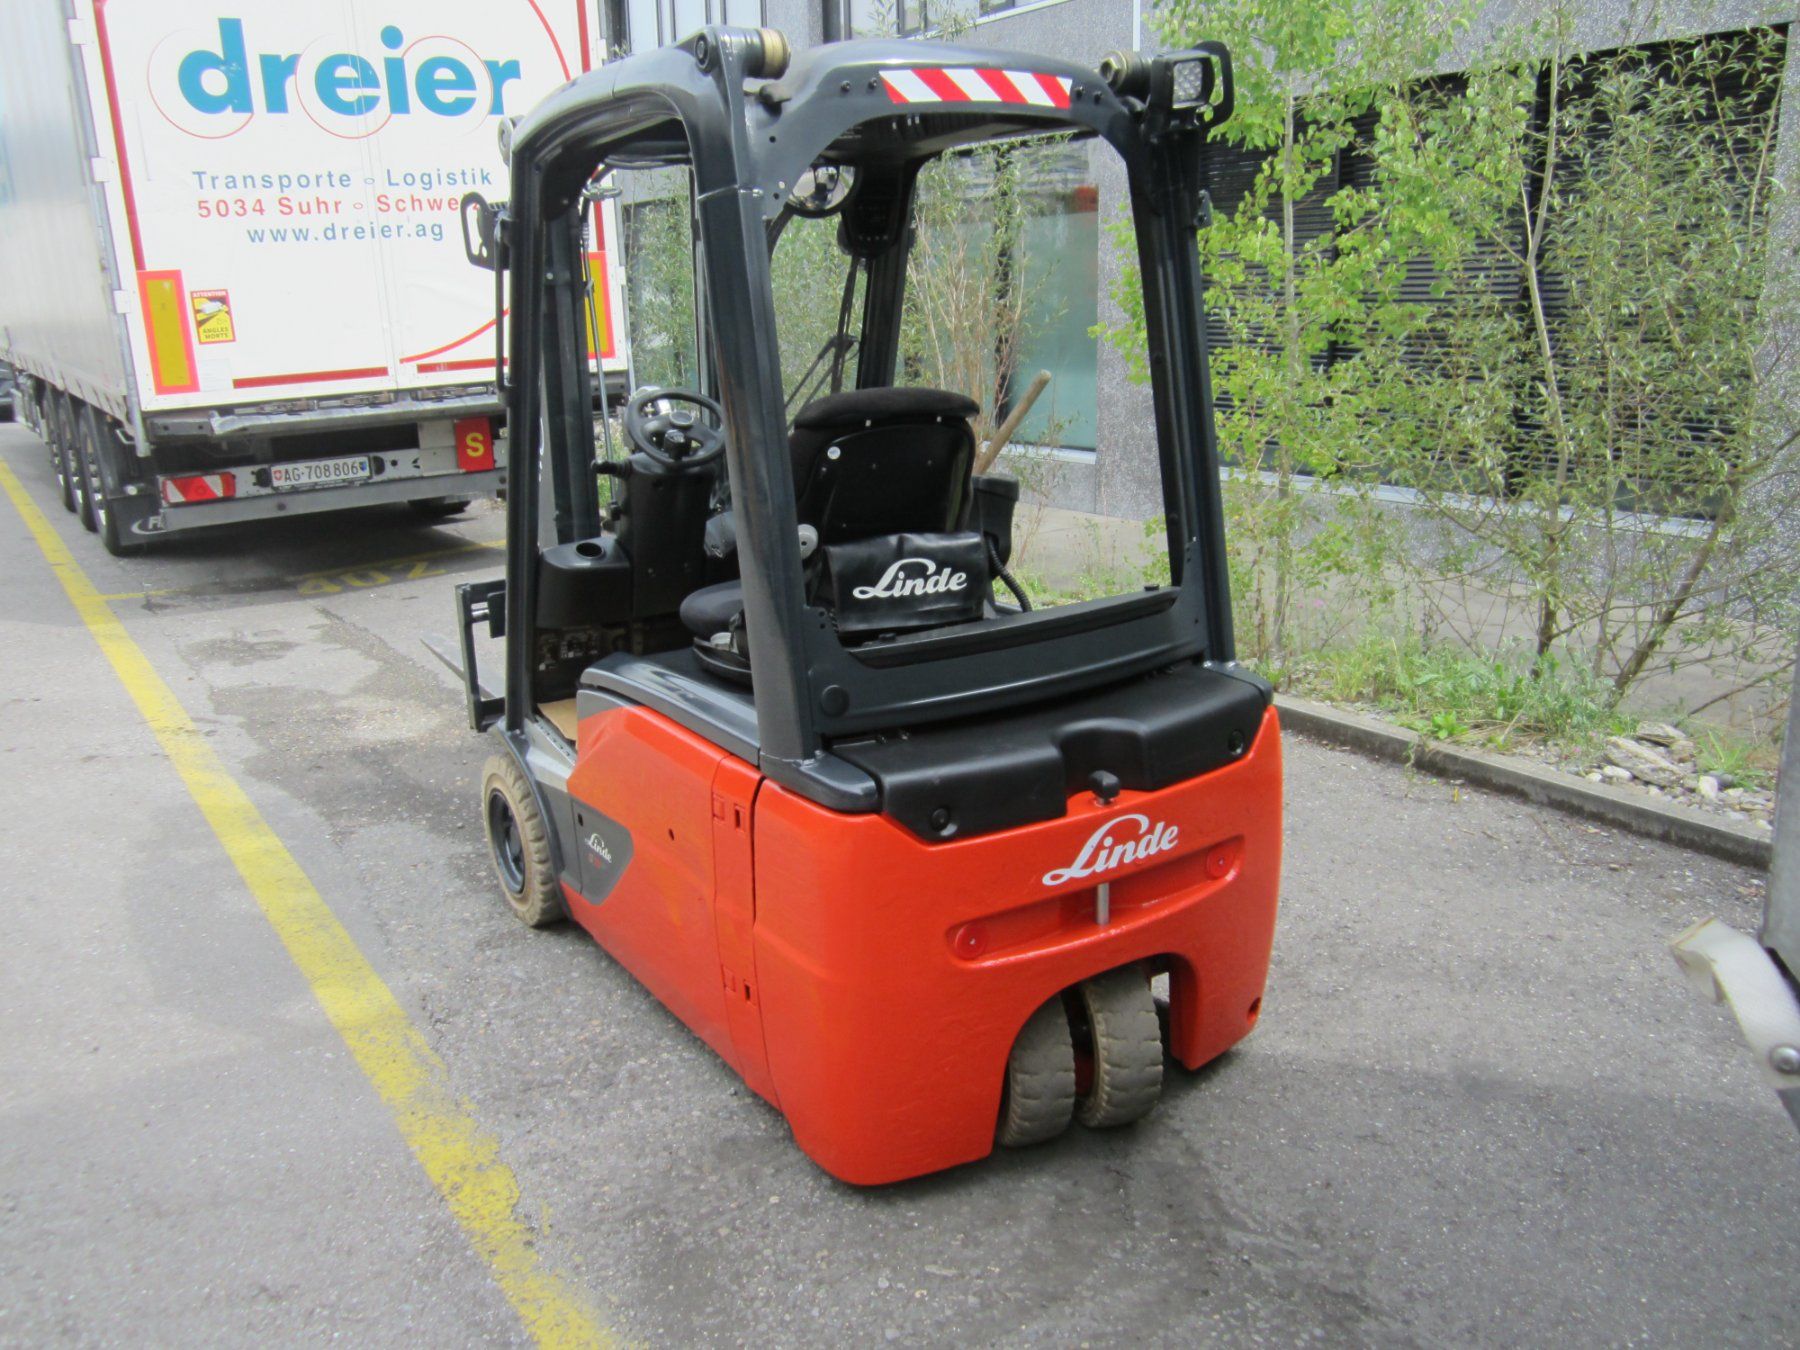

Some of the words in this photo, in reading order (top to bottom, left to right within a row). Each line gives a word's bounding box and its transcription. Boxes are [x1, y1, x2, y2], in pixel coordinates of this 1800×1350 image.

[178, 18, 521, 117] dreier
[192, 170, 352, 192] Transporte
[386, 168, 492, 190] Logistik
[198, 197, 265, 218] 5034
[278, 196, 342, 215] Suhr
[247, 222, 444, 243] www.dreier.ag
[465, 433, 485, 457] S
[852, 557, 968, 599] Linde
[585, 833, 612, 863] Linde
[1042, 814, 1179, 886] Linde
